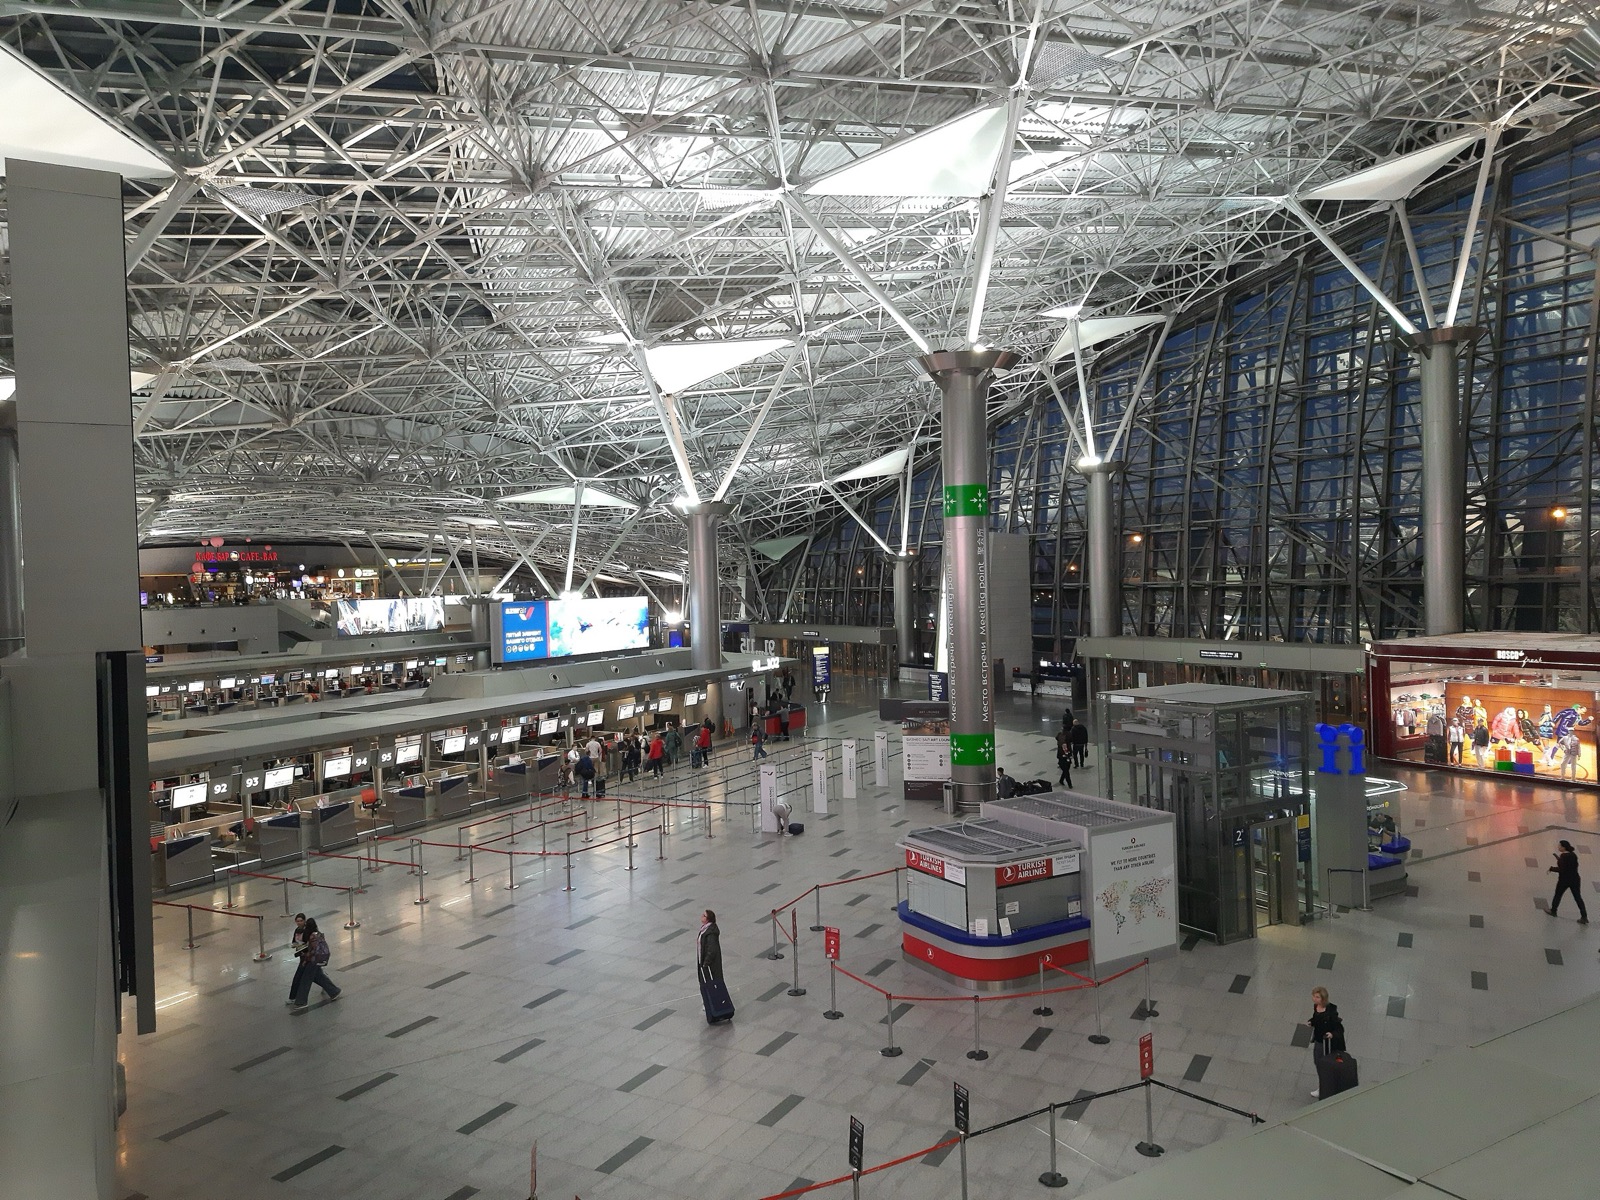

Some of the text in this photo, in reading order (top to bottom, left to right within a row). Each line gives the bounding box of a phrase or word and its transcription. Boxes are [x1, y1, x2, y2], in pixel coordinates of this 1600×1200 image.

[240, 552, 278, 560] CAFE-BAR
[978, 562, 986, 589] point
[1497, 650, 1519, 660] BOSCO
[635, 705, 644, 714] 100
[469, 736, 479, 746] 96
[490, 733, 498, 741] 97
[356, 757, 367, 767] 94
[381, 752, 392, 762] 95
[246, 777, 259, 788] 93
[214, 783, 227, 794] 92
[920, 854, 941, 866] TURKISH
[920, 861, 942, 874] AIRLINES
[1018, 860, 1046, 871] TURKISH
[1018, 867, 1046, 879] AIRLINES
